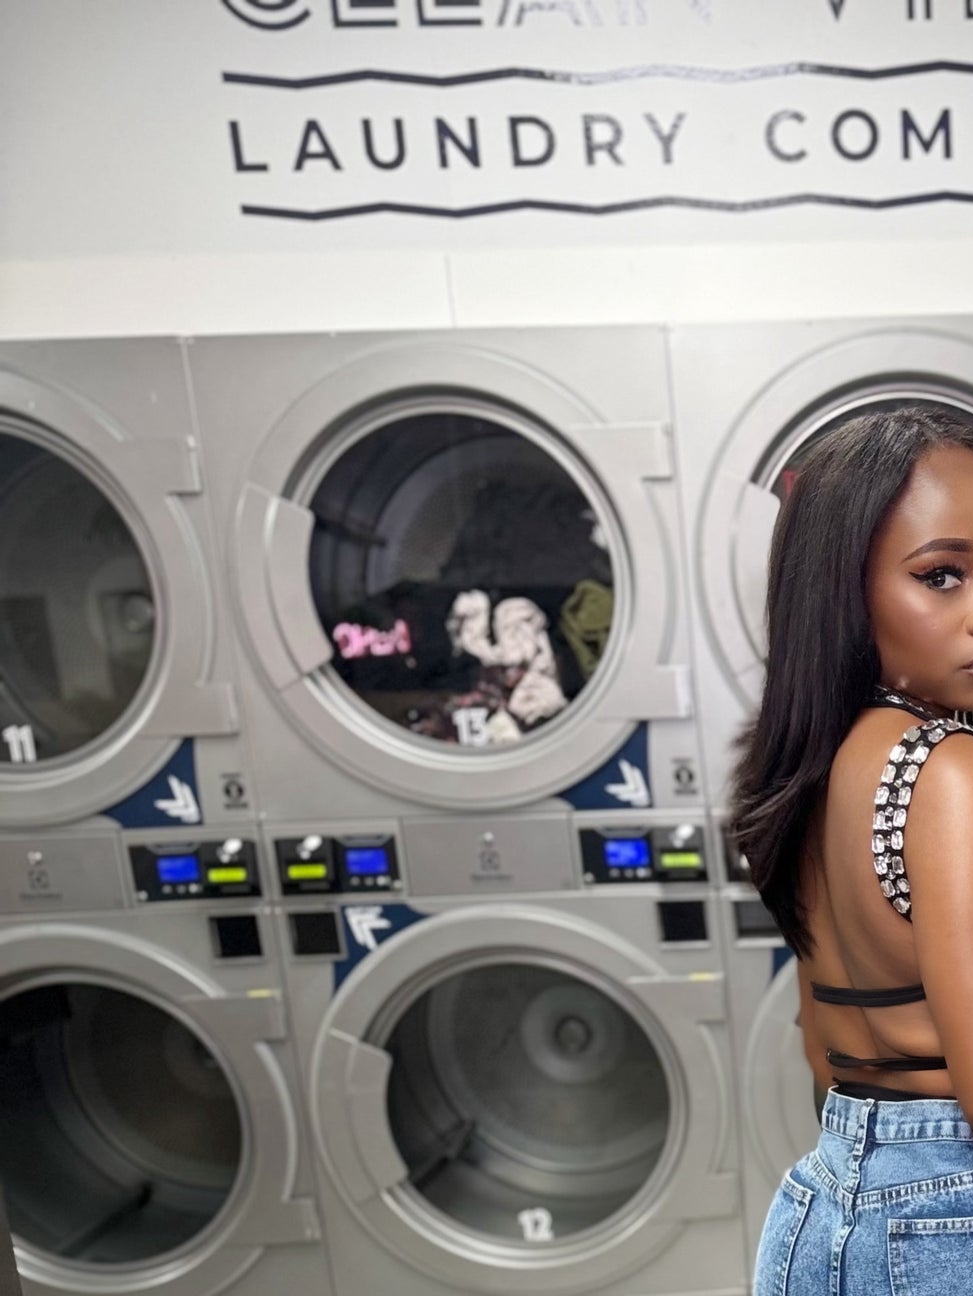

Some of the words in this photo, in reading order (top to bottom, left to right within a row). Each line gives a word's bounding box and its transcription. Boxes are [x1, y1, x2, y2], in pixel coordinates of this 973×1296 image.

[229, 112, 686, 173] LAUNDRY
[2, 725, 37, 763] 11
[452, 707, 489, 747] 13
[518, 1207, 555, 1242] 12
